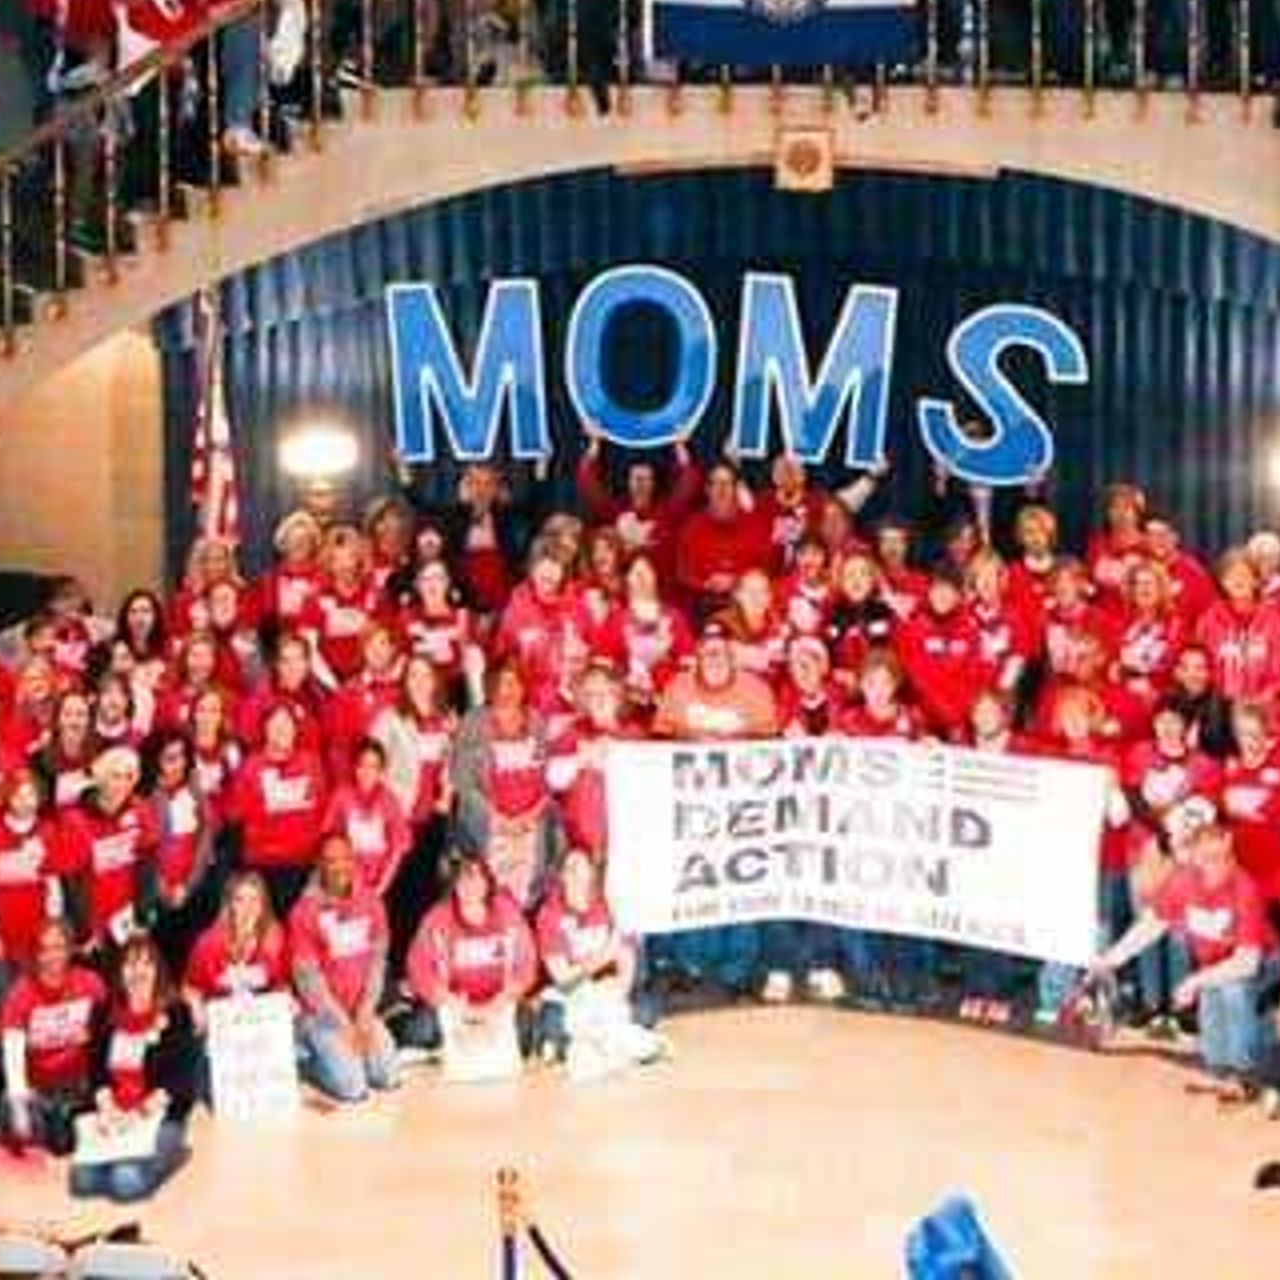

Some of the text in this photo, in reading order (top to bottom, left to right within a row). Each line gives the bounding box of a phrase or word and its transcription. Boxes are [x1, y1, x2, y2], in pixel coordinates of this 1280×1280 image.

[384, 264, 1089, 486] MOMS
[672, 745, 899, 788] MOMS
[673, 794, 993, 849] DEMAND
[673, 842, 949, 896] ACTION
